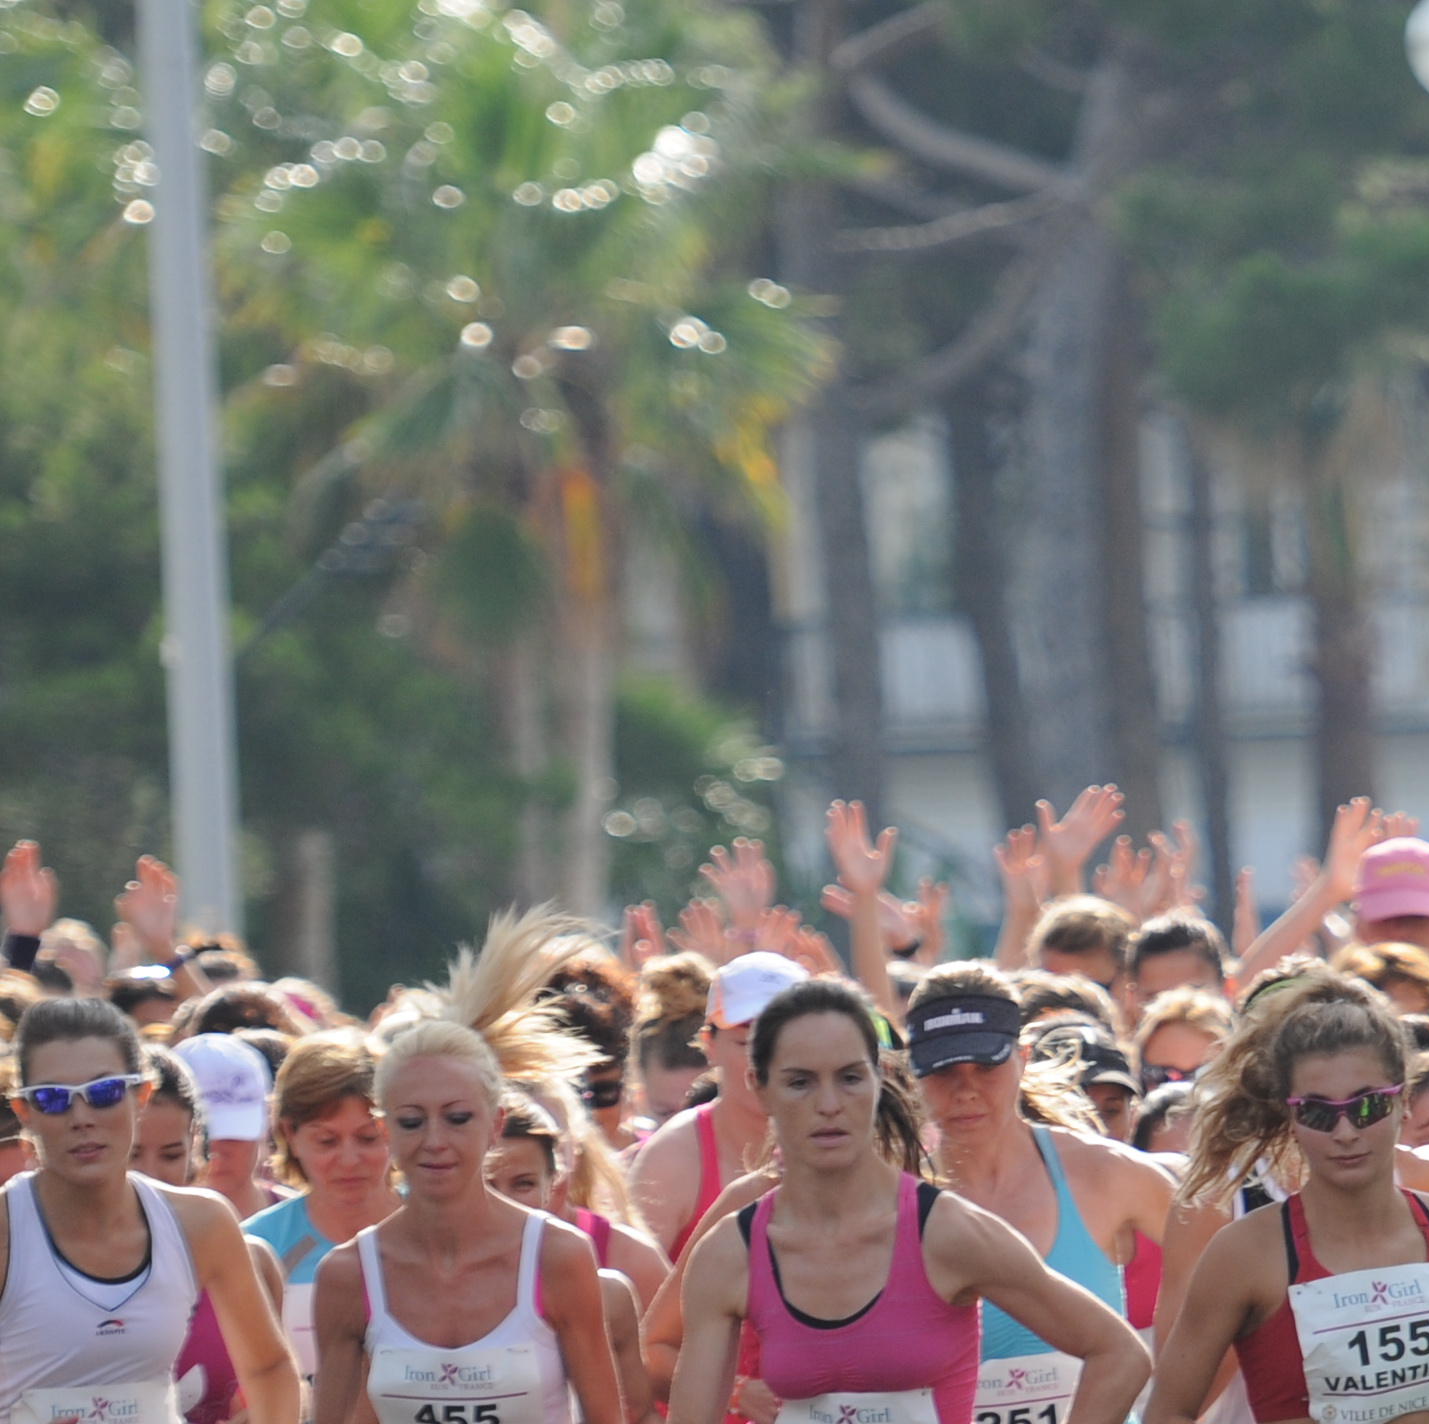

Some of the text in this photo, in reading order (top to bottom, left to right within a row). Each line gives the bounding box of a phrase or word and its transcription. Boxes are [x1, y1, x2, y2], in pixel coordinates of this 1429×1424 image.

[1333, 1279, 1422, 1308] Iron Girl
[1392, 1296, 1425, 1308] FRANCE
[404, 1364, 493, 1382] Iron Girl
[1026, 1367, 1059, 1384] Girl
[459, 1382, 494, 1390] FRANCE
[108, 1399, 139, 1416] Girl
[809, 1404, 892, 1424] Iron Girl
[1340, 1396, 1428, 1422] VILLE DE NICE
